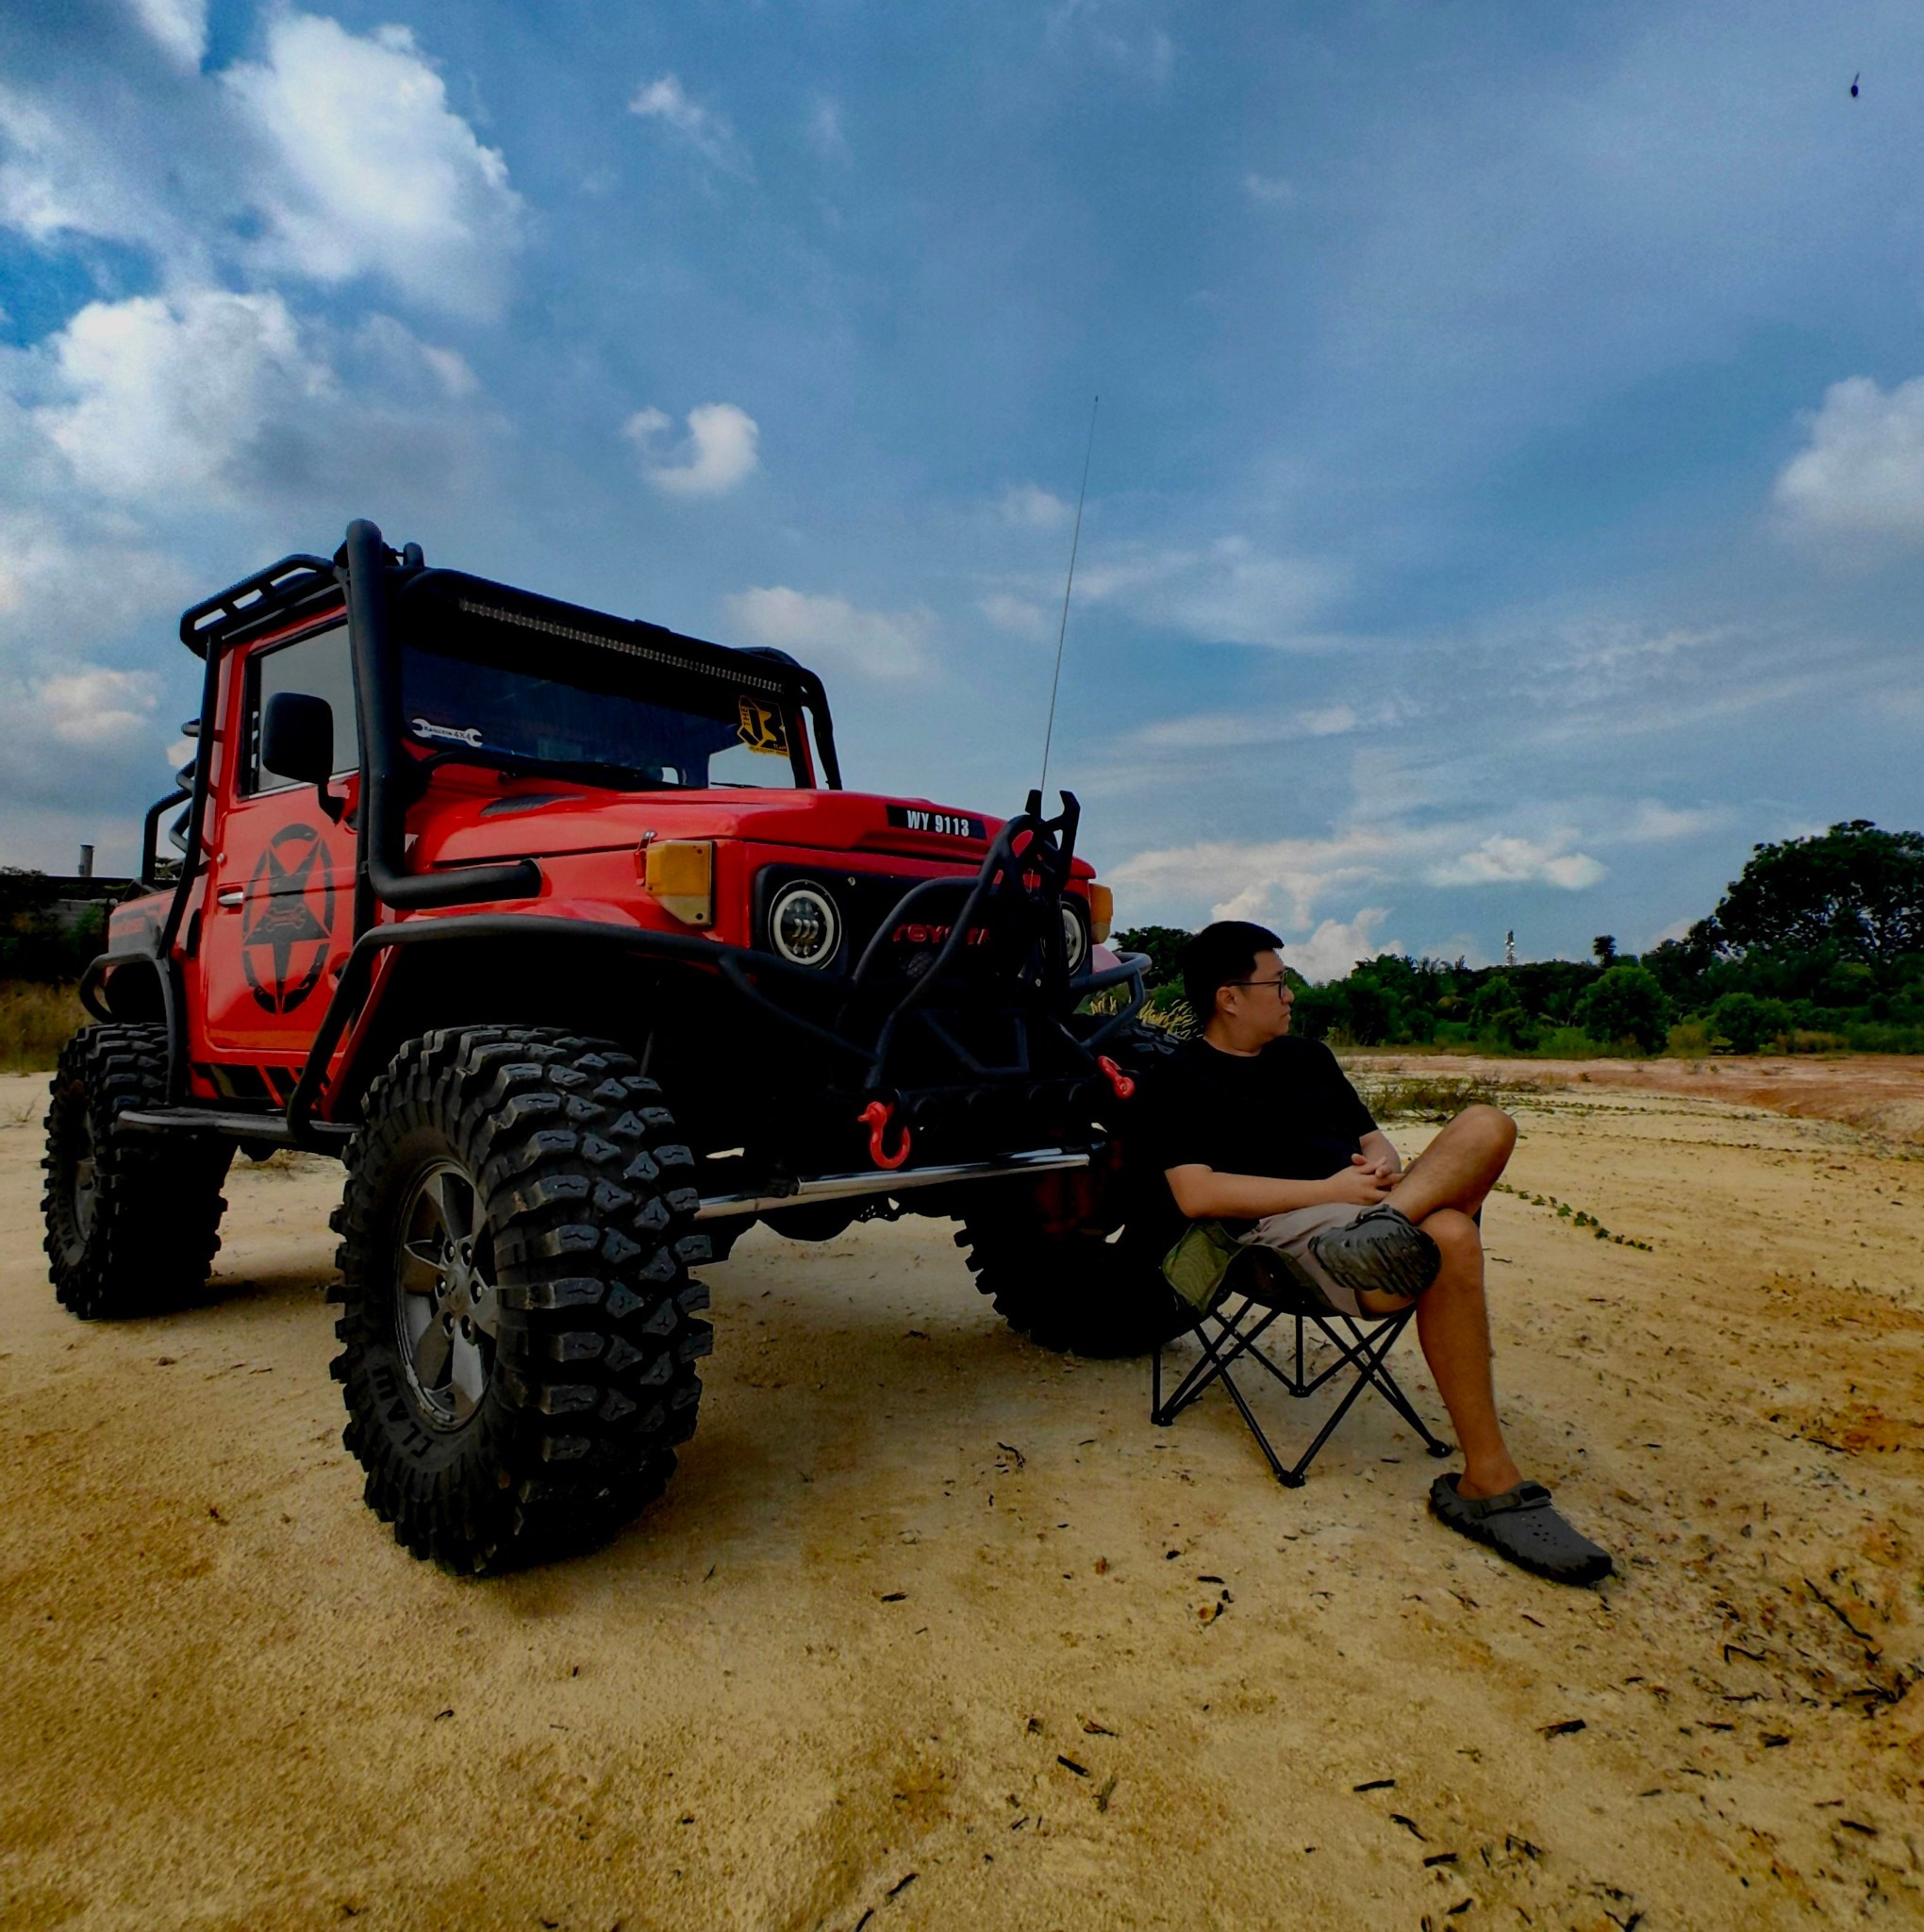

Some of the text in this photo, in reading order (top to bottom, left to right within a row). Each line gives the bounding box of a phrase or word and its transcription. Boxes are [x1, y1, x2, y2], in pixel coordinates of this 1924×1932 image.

[739, 707, 751, 727] THE
[906, 809, 970, 838] WY 9113
[373, 1365, 434, 1458] CLAW
